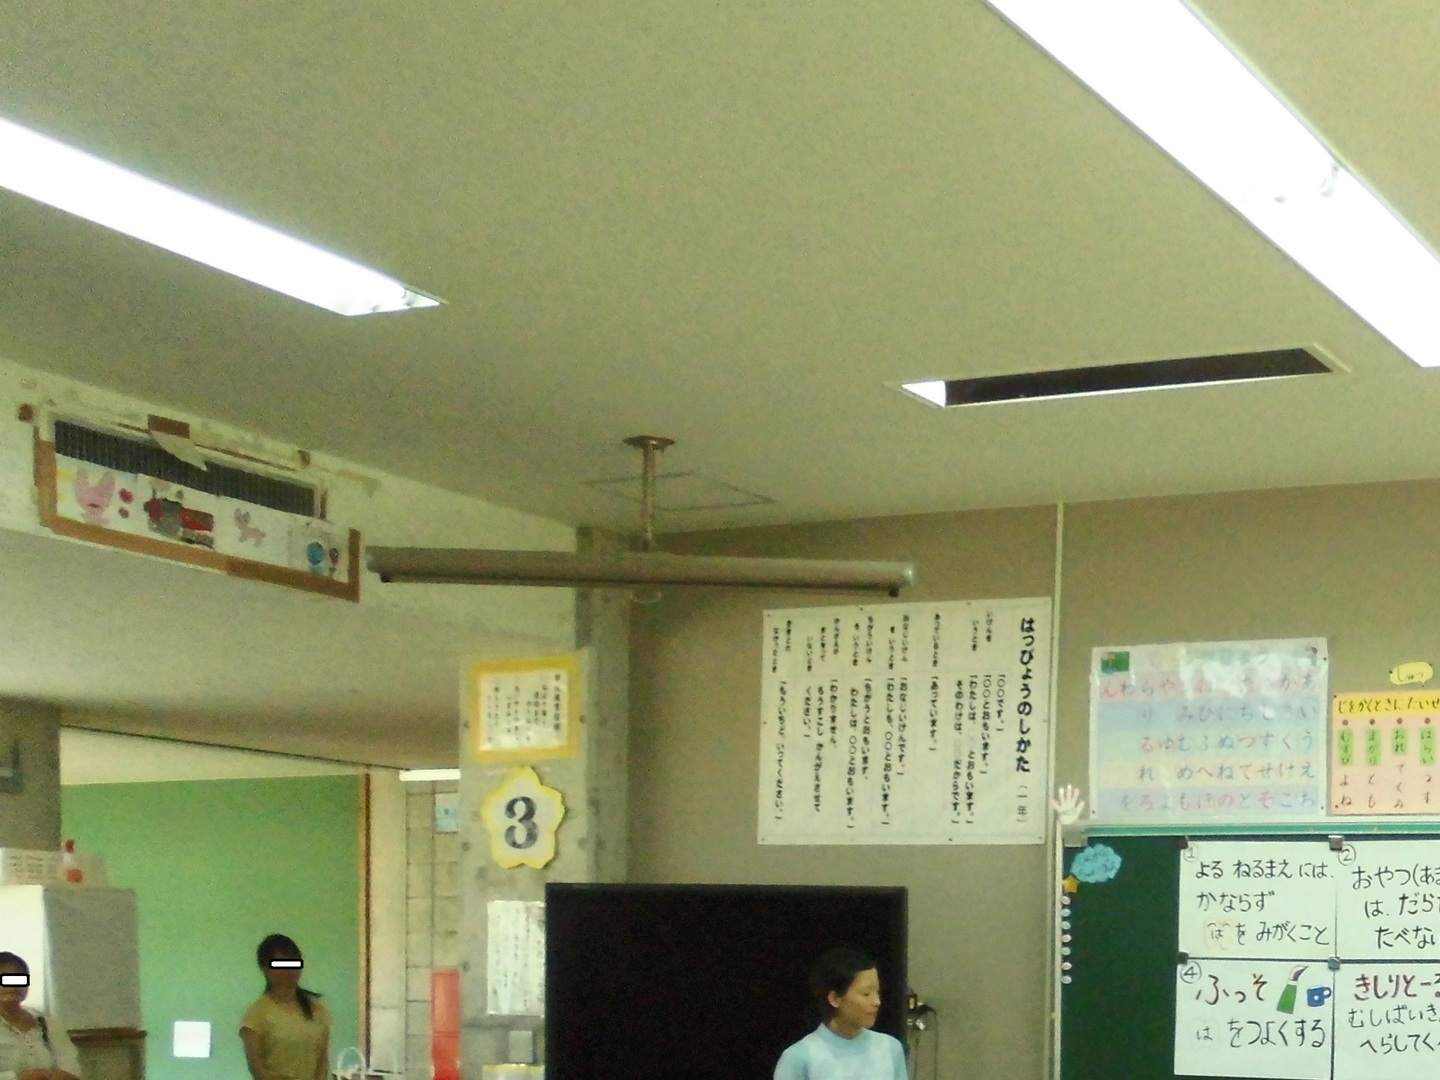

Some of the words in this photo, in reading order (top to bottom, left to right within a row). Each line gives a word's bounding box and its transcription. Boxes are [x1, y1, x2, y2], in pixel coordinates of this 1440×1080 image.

[1017, 617, 1035, 772] はっぴょうのしかた
[504, 796, 538, 849] 3
[1195, 860, 1224, 879] よる
[1232, 859, 1293, 879] ねるまえ
[1196, 890, 1275, 912] かならず
[1211, 928, 1224, 939] は
[1256, 920, 1330, 946] みがくこと
[1196, 973, 1267, 1005] ふっそ
[1197, 1026, 1212, 1040] は
[1228, 1018, 1326, 1048] をつよくする
